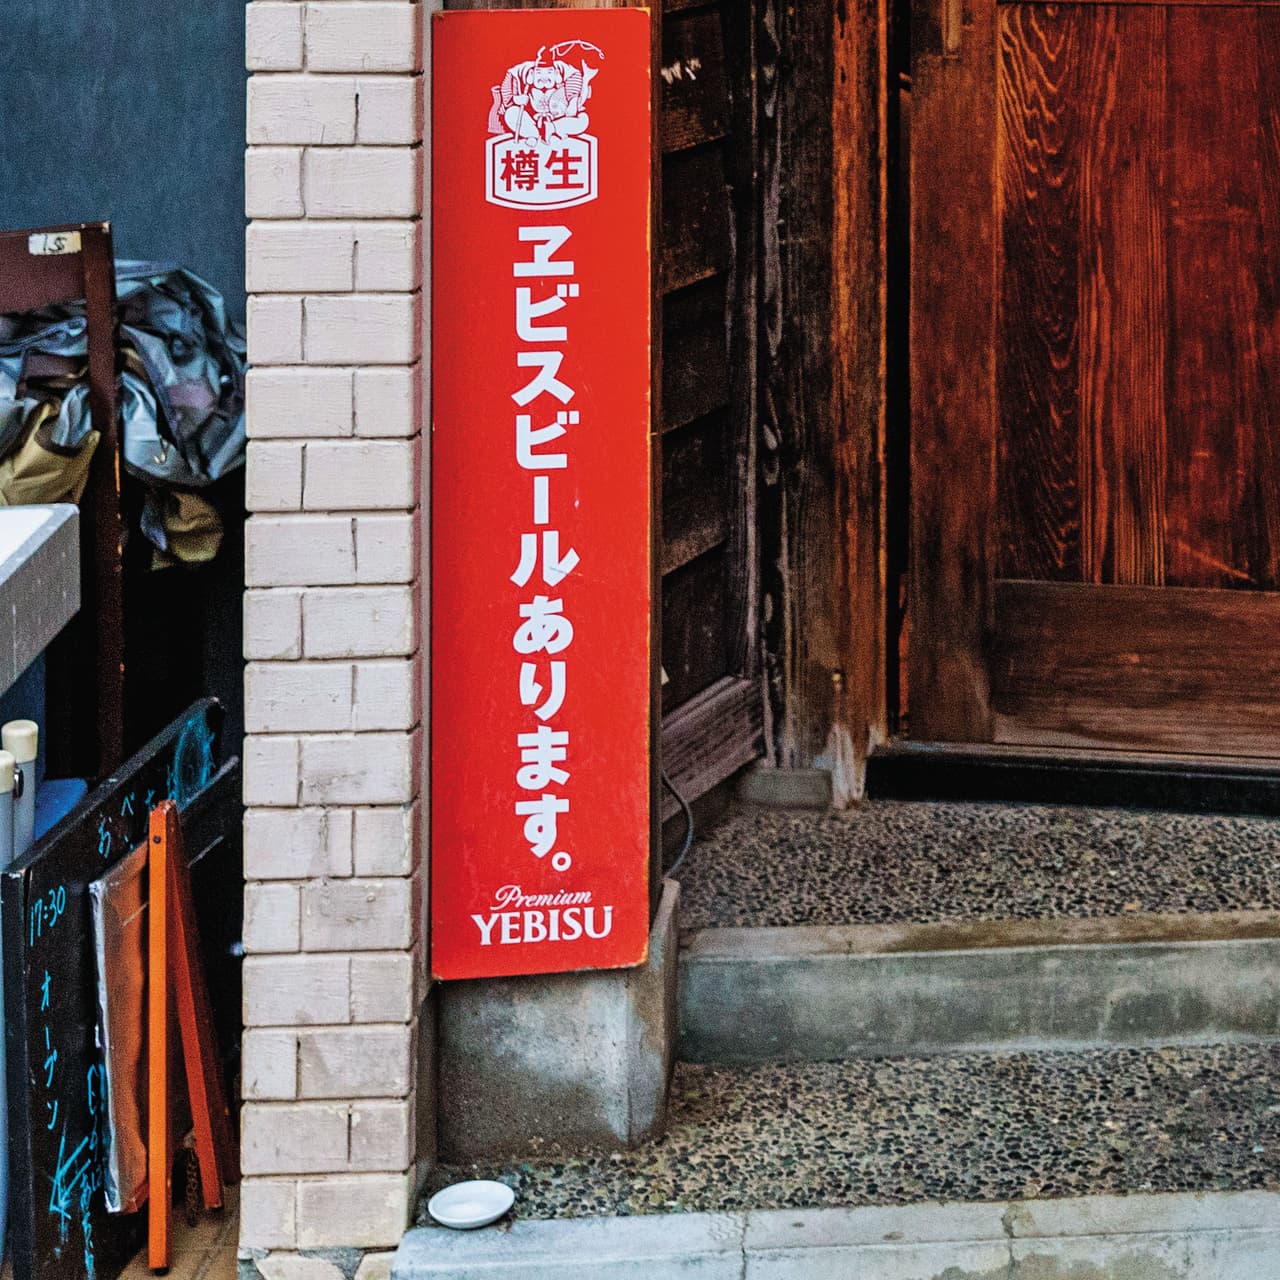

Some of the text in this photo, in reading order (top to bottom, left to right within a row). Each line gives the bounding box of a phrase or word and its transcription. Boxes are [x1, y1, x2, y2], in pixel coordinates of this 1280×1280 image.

[499, 148, 585, 192] 樽生
[29, 884, 66, 948] 17:30
[490, 884, 593, 911] Premium
[471, 905, 615, 947] YEBISU
[40, 969, 59, 1131] オープン
